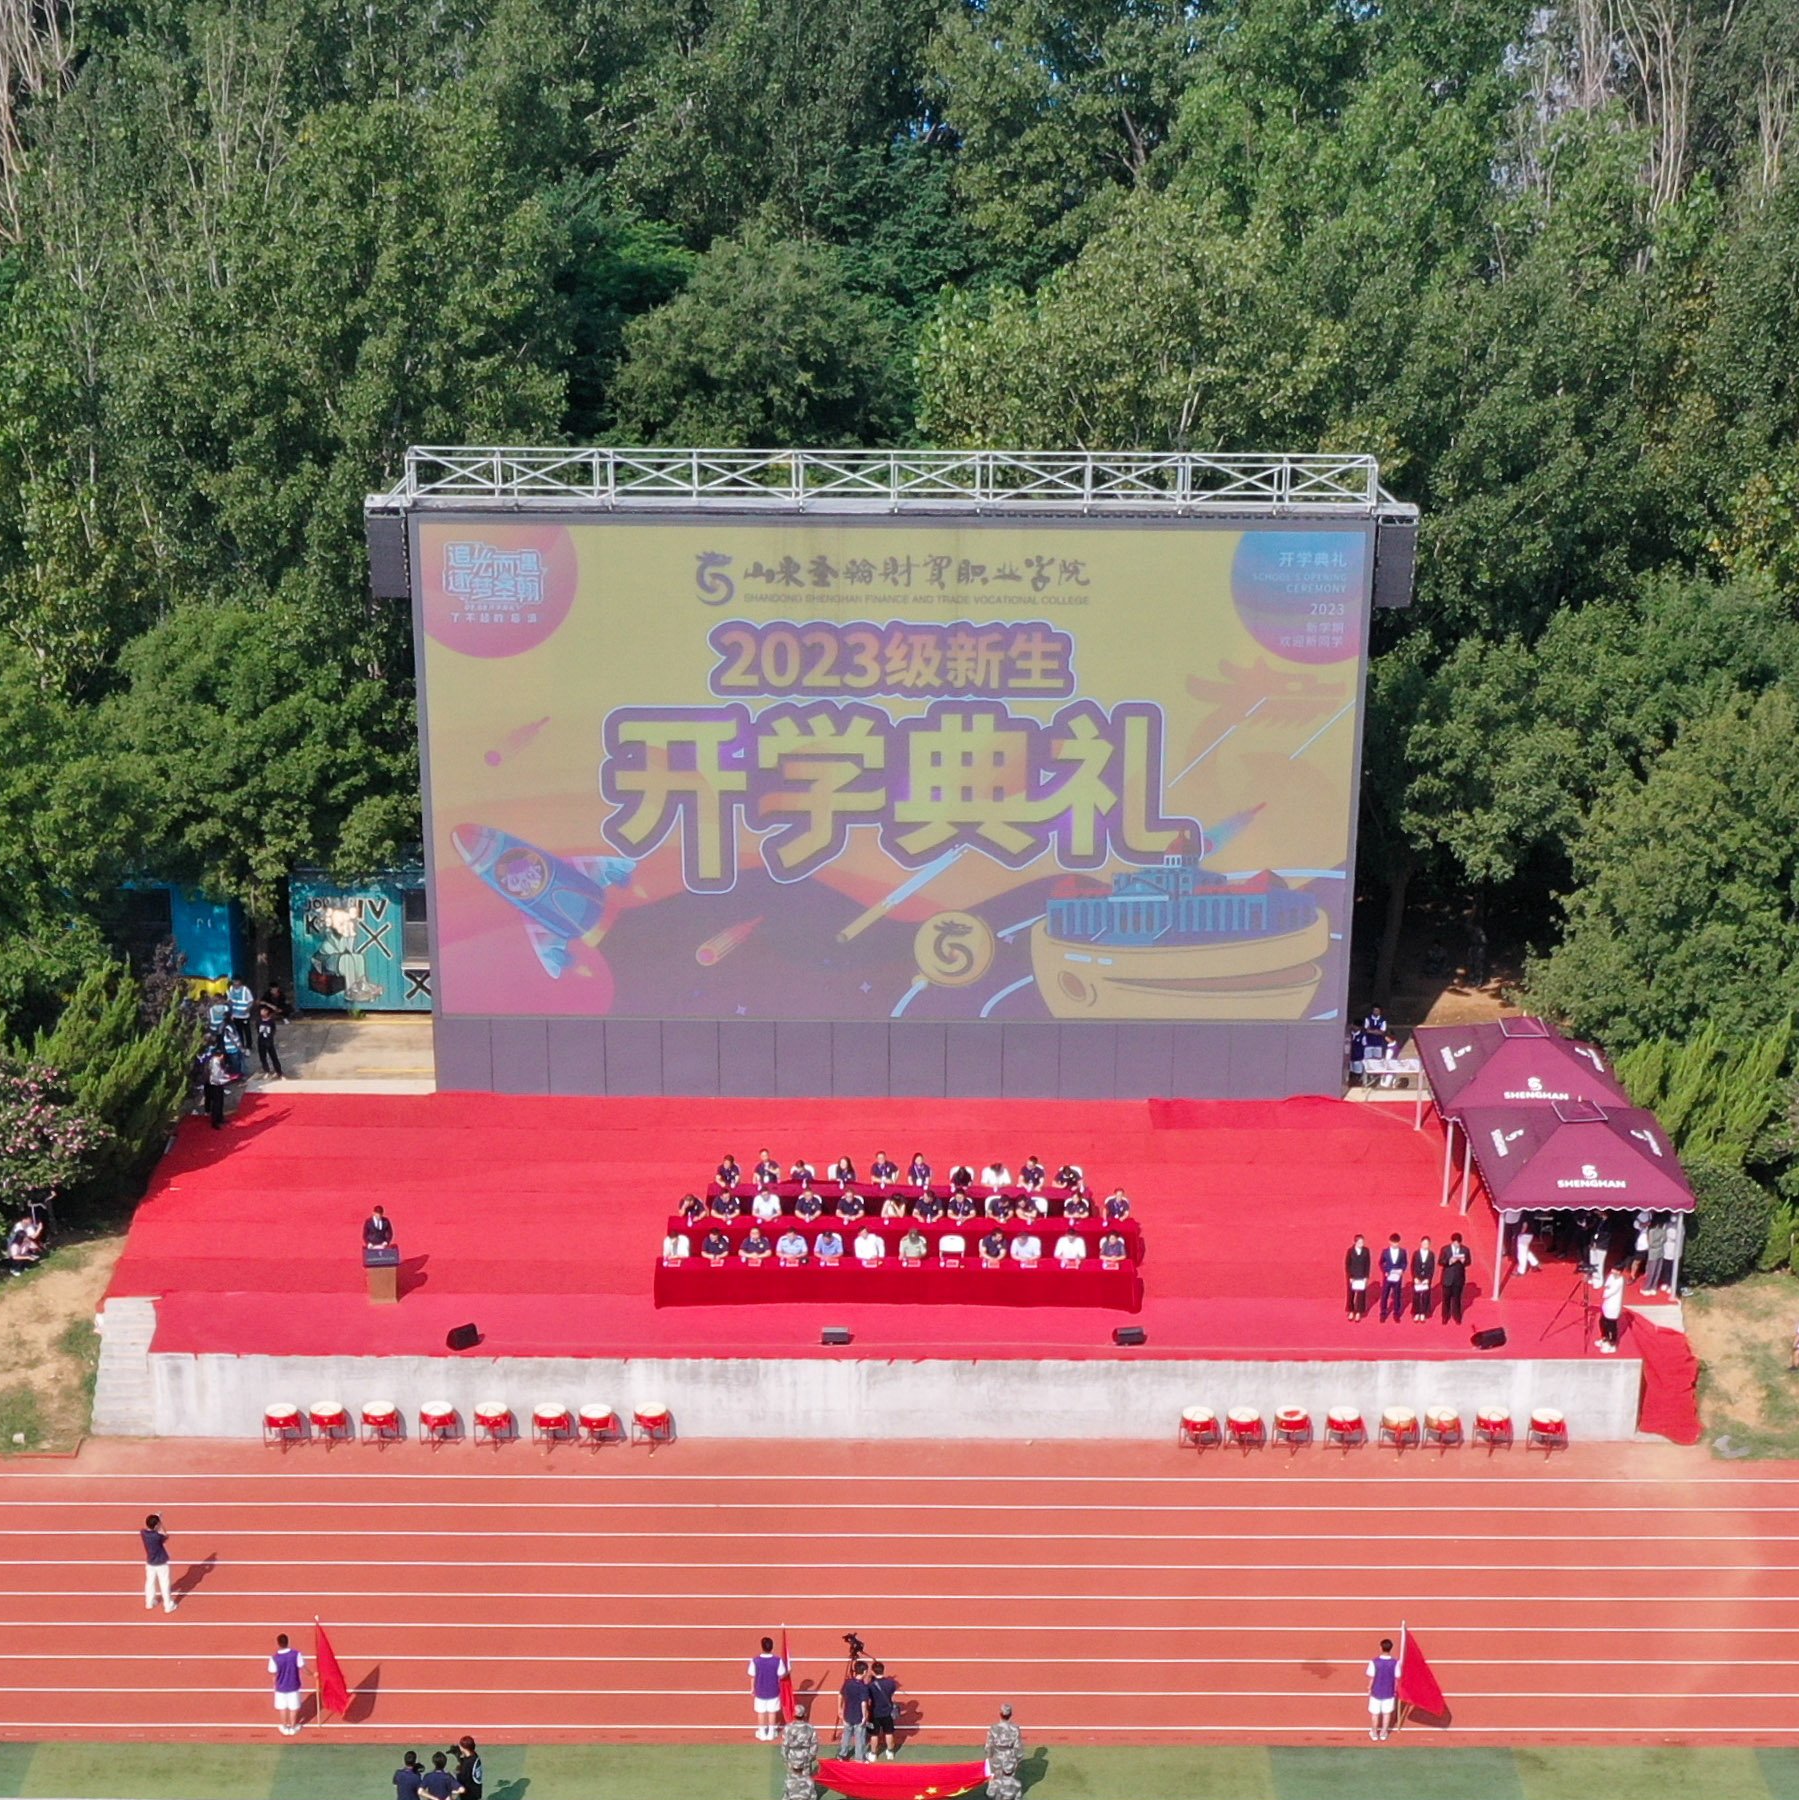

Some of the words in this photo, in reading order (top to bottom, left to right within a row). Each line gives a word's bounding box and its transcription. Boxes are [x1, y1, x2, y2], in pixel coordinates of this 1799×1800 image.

[1279, 552, 1348, 567] 开学典礼
[1285, 583, 1347, 594] CEREMONY
[912, 594, 934, 604] AND
[937, 594, 969, 604] TRADE
[973, 595, 1039, 605] VOCATIONAL
[1041, 595, 1089, 605] COLLEGE
[1309, 603, 1345, 616] 2023
[718, 630, 1066, 690] 2023级新生
[614, 712, 1189, 880] 开学典礼
[1504, 1091, 1569, 1100] SHENGHAN
[1557, 1179, 1626, 1188] SHENGHAN
